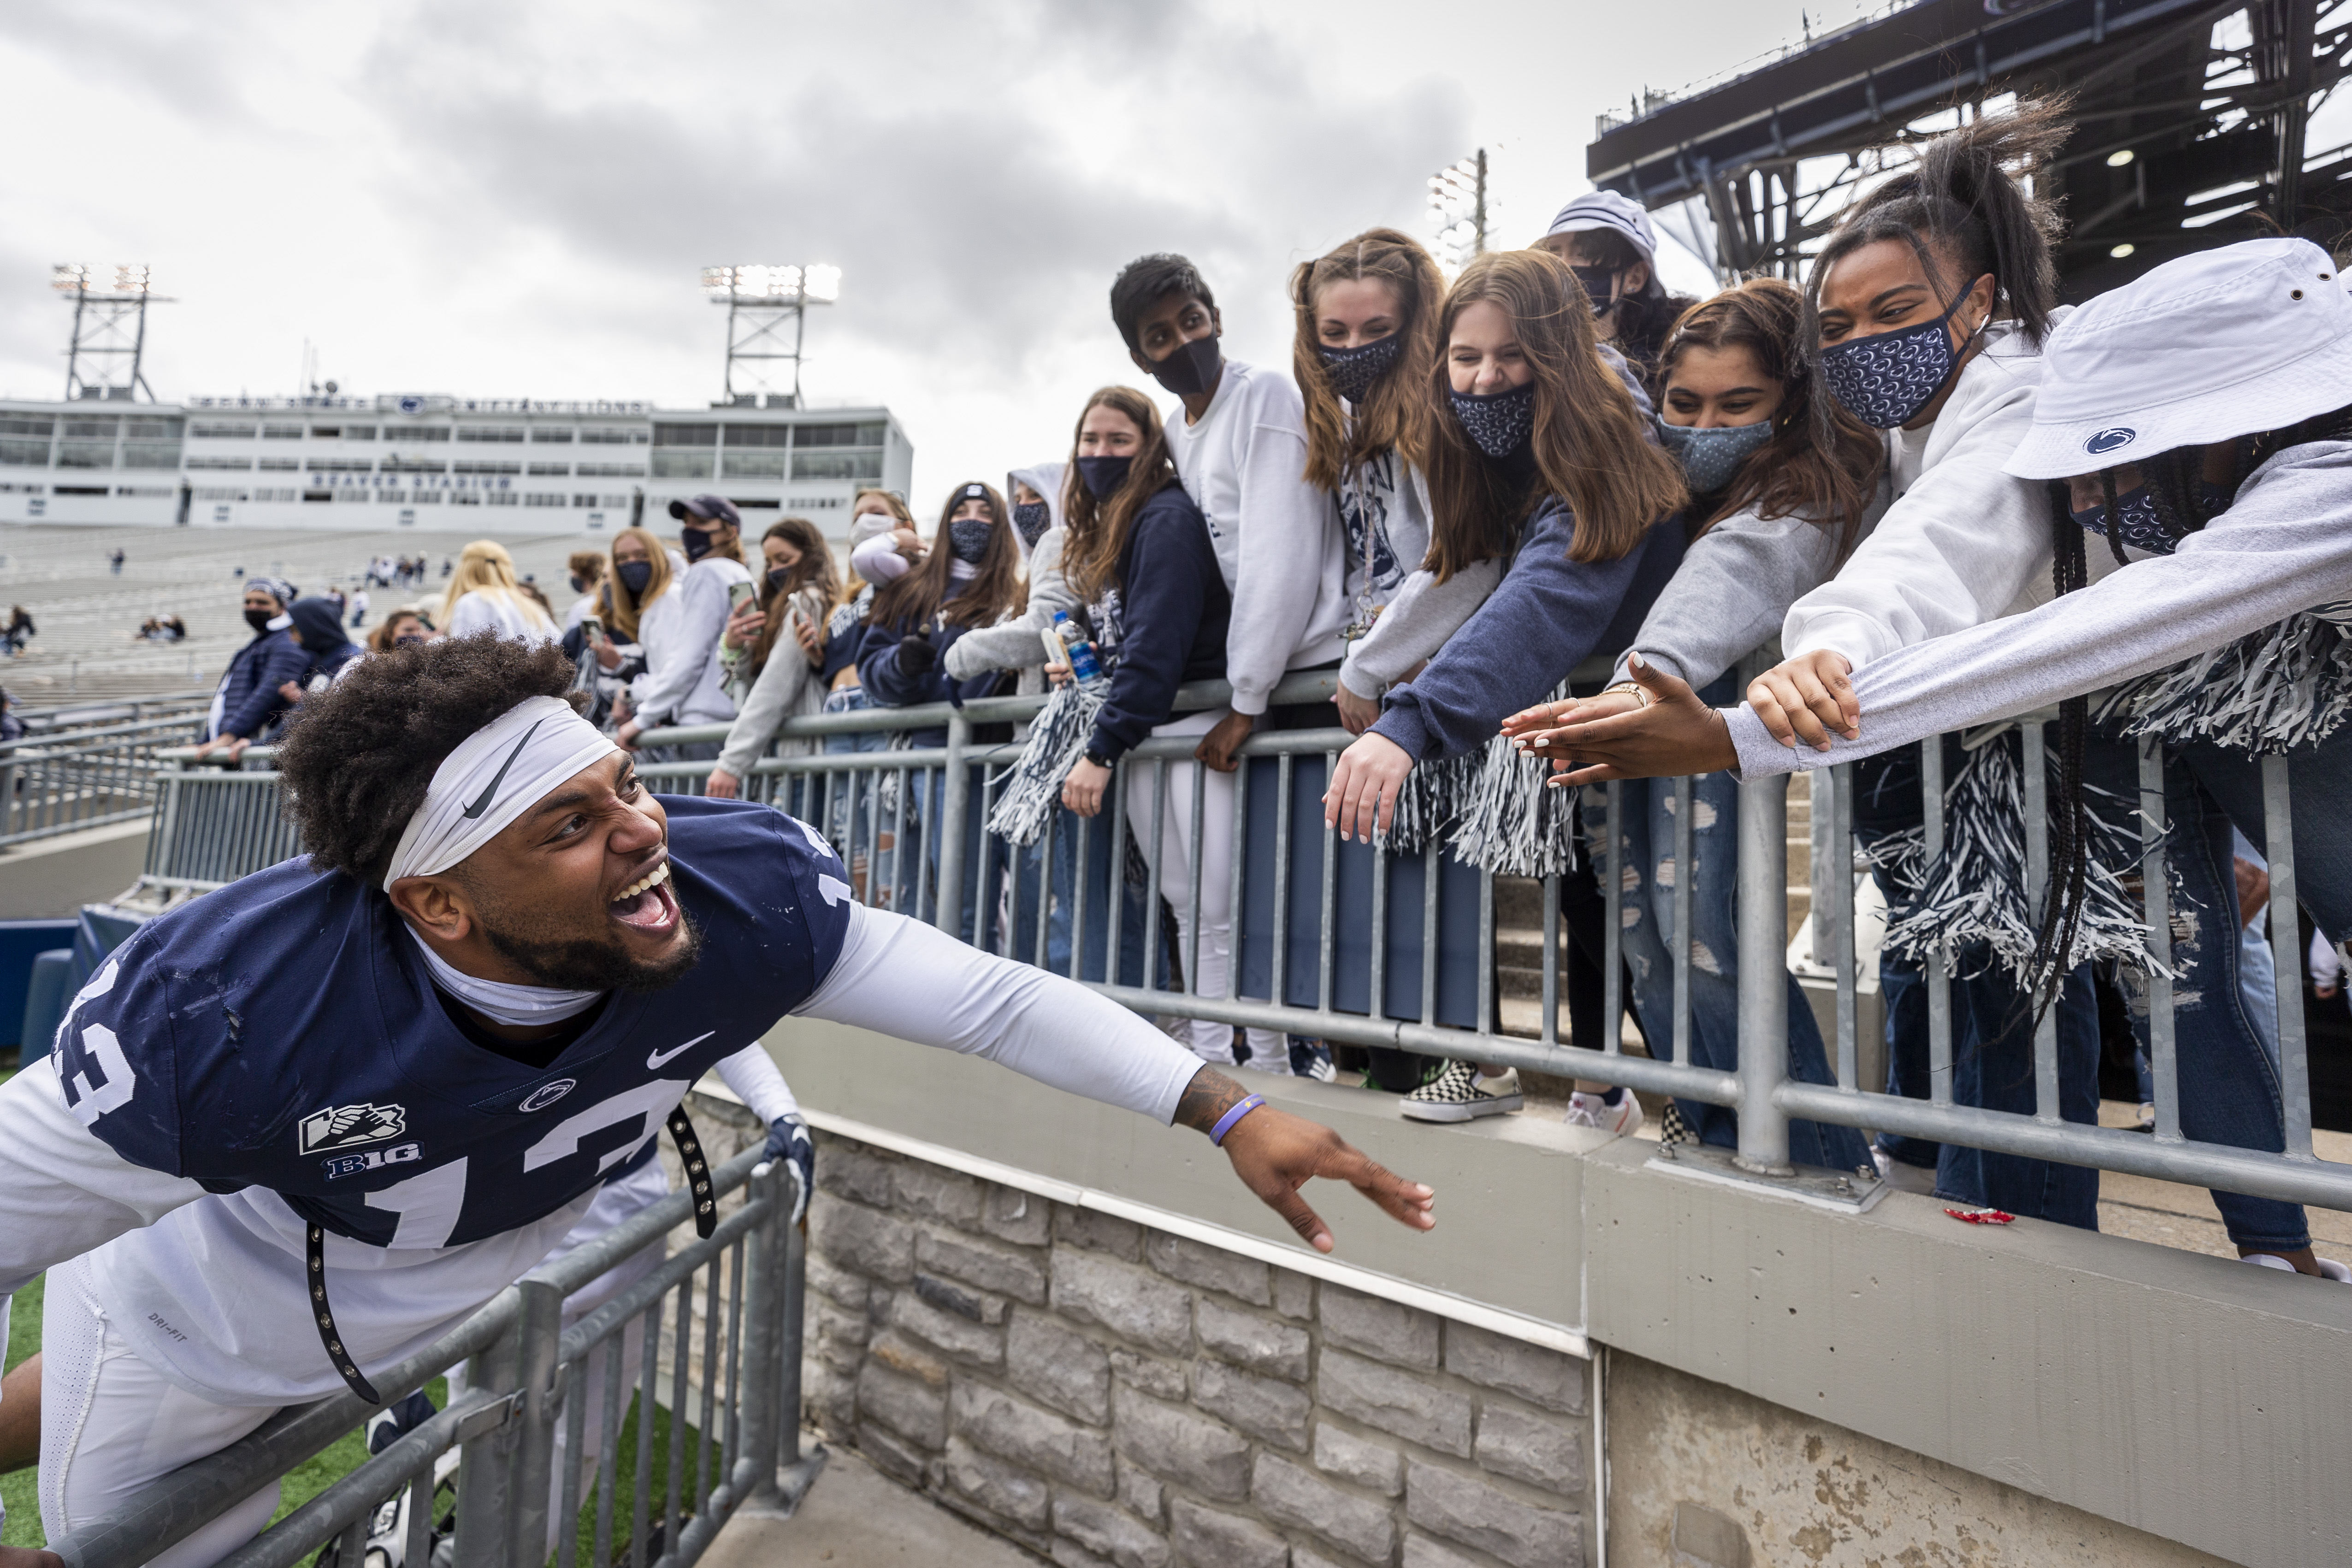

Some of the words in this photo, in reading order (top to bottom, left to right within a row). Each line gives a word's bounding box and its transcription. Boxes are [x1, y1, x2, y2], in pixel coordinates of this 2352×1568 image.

[313, 474, 397, 486] BEAVER
[415, 477, 511, 489] STADIUM
[148, 1313, 187, 1342] DRI-FIT
